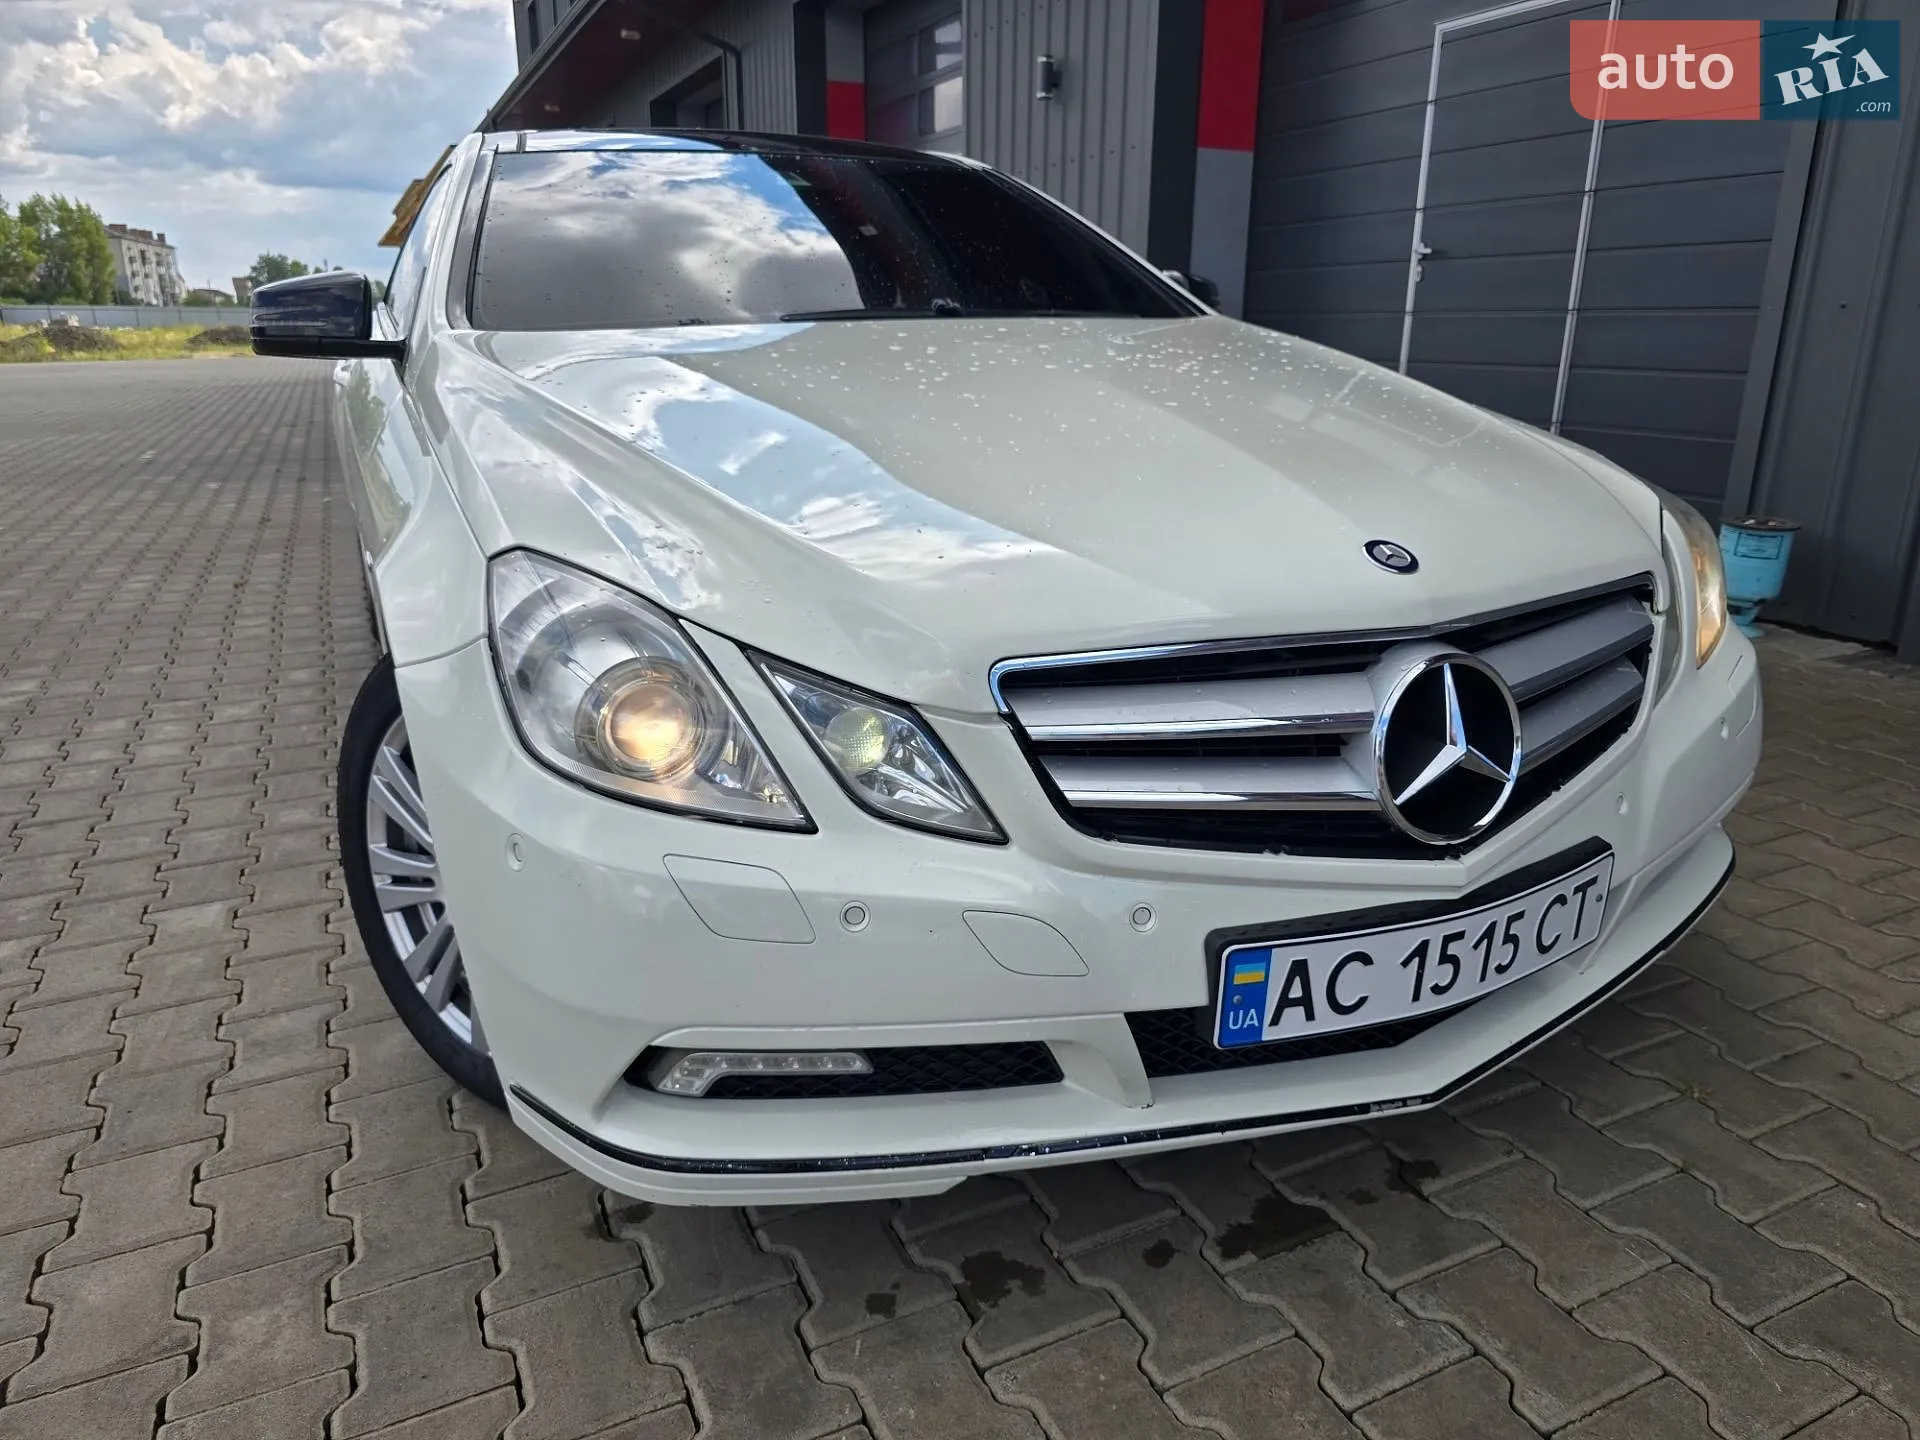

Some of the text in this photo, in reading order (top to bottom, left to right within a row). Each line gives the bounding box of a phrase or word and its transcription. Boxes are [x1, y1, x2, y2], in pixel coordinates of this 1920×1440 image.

[1268, 874, 1600, 1028] AC 1515 CT
[1228, 1008, 1260, 1031] UA
